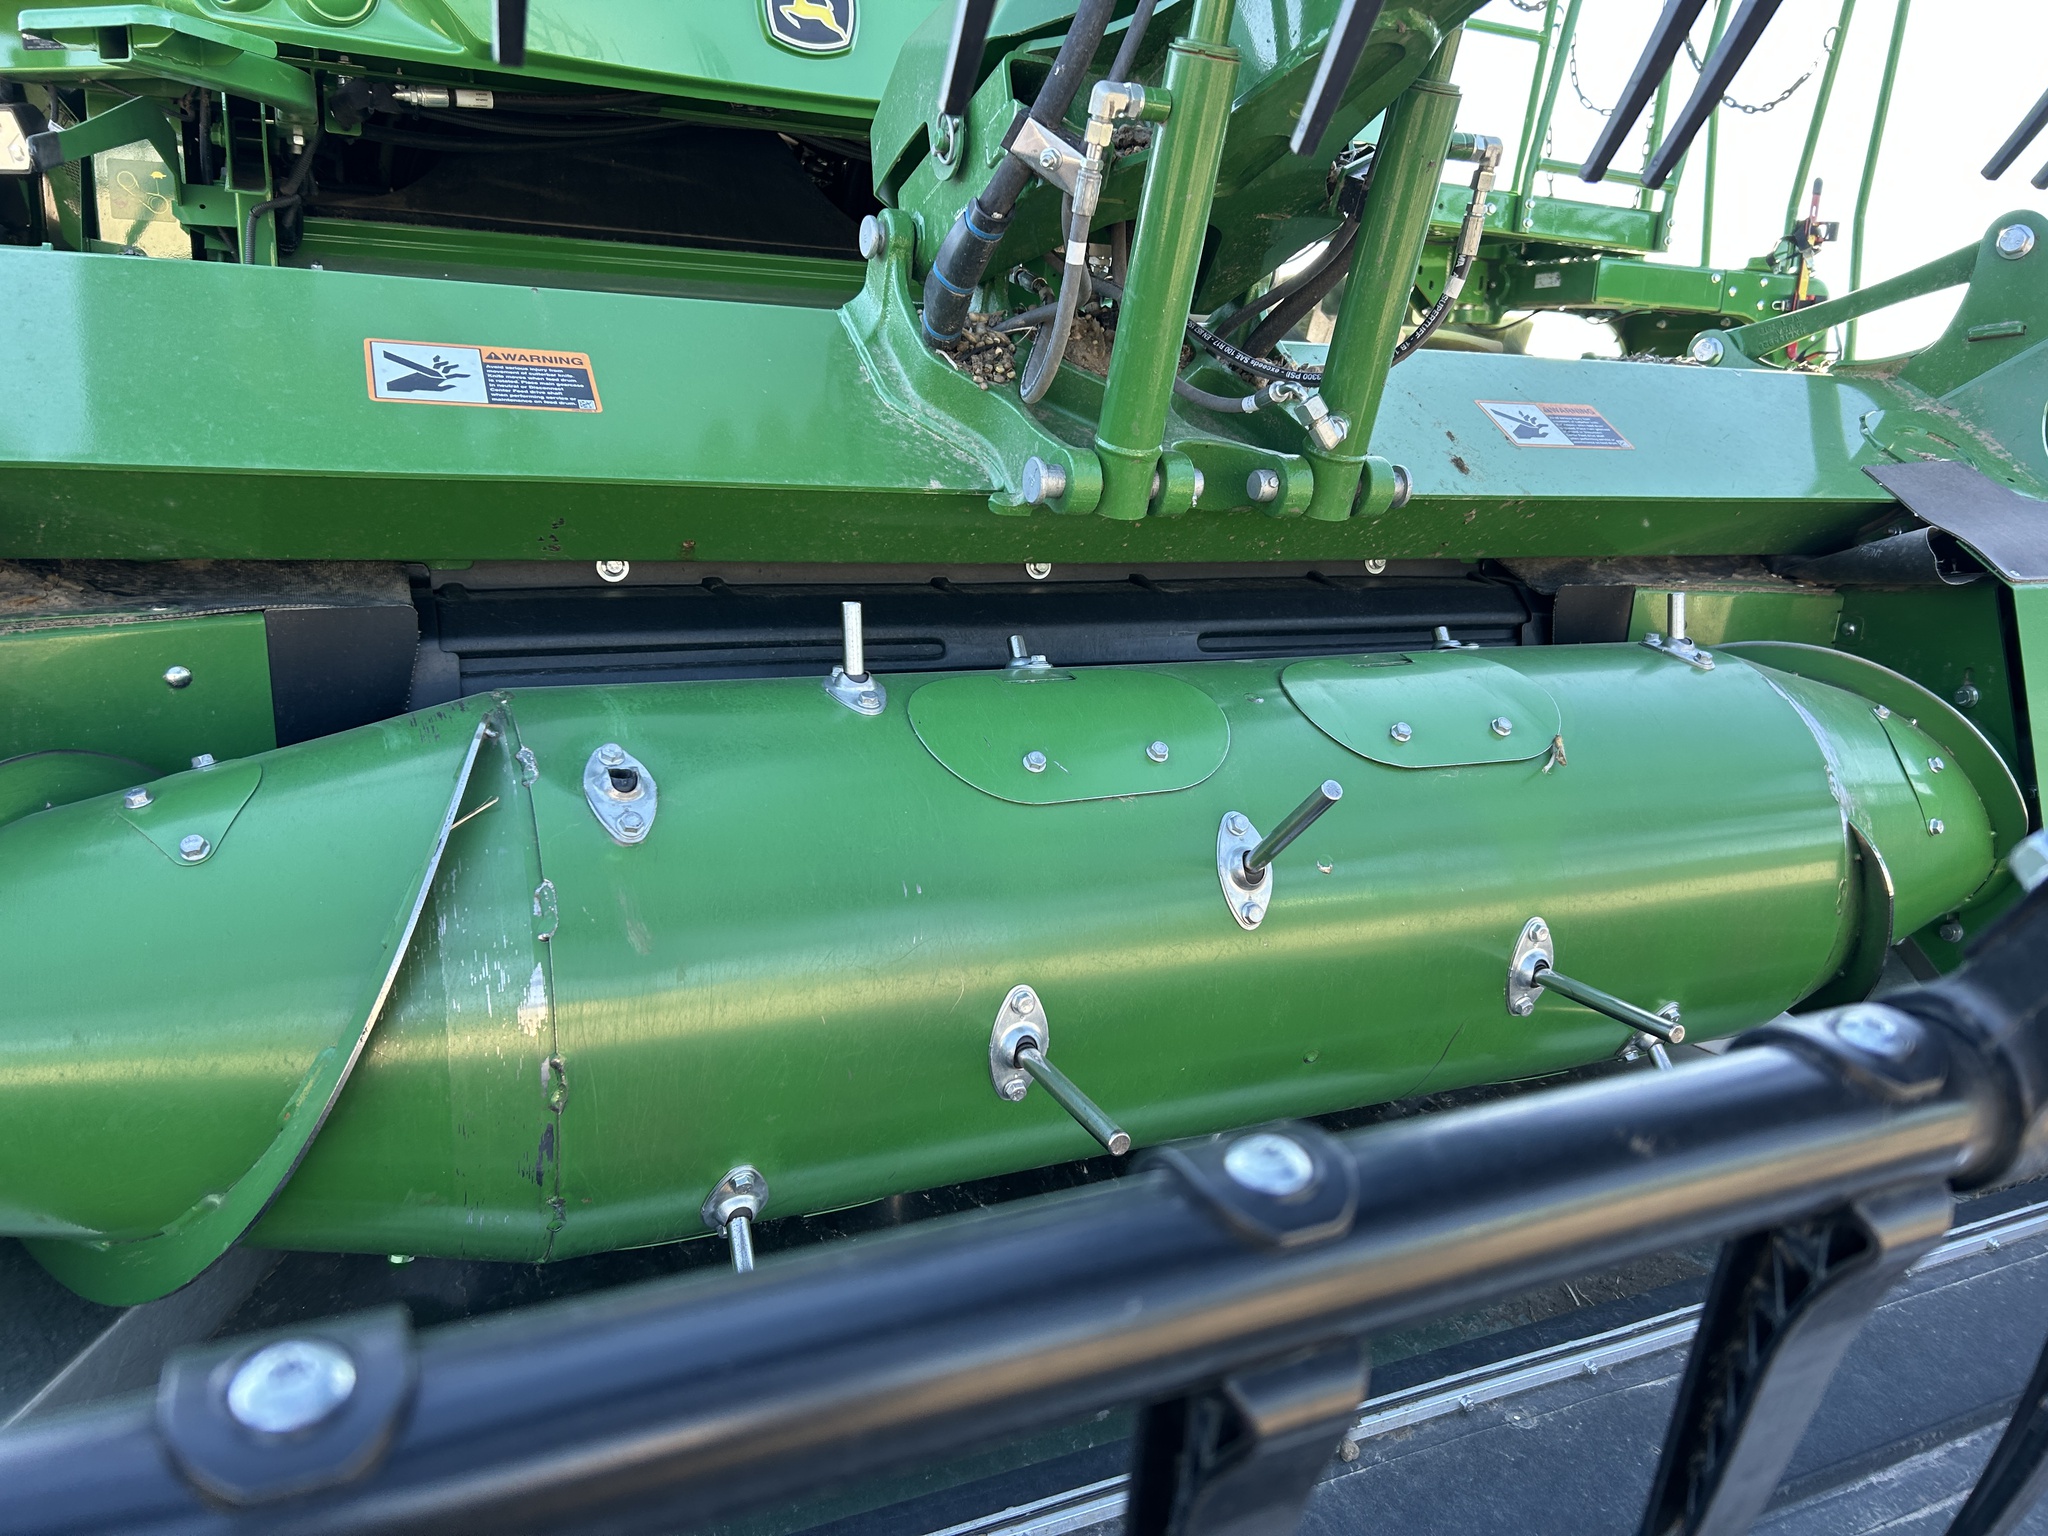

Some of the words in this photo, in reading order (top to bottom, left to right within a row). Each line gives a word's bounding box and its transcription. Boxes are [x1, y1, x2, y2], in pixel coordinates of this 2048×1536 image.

[1415, 294, 1449, 339] SUPERTUFF
[1212, 341, 1225, 350] R17
[1223, 346, 1235, 356] 100
[501, 353, 584, 366] WARNING
[1235, 353, 1250, 364] SAE
[1249, 359, 1280, 374] exceeds
[1549, 407, 1595, 415] WARNING
